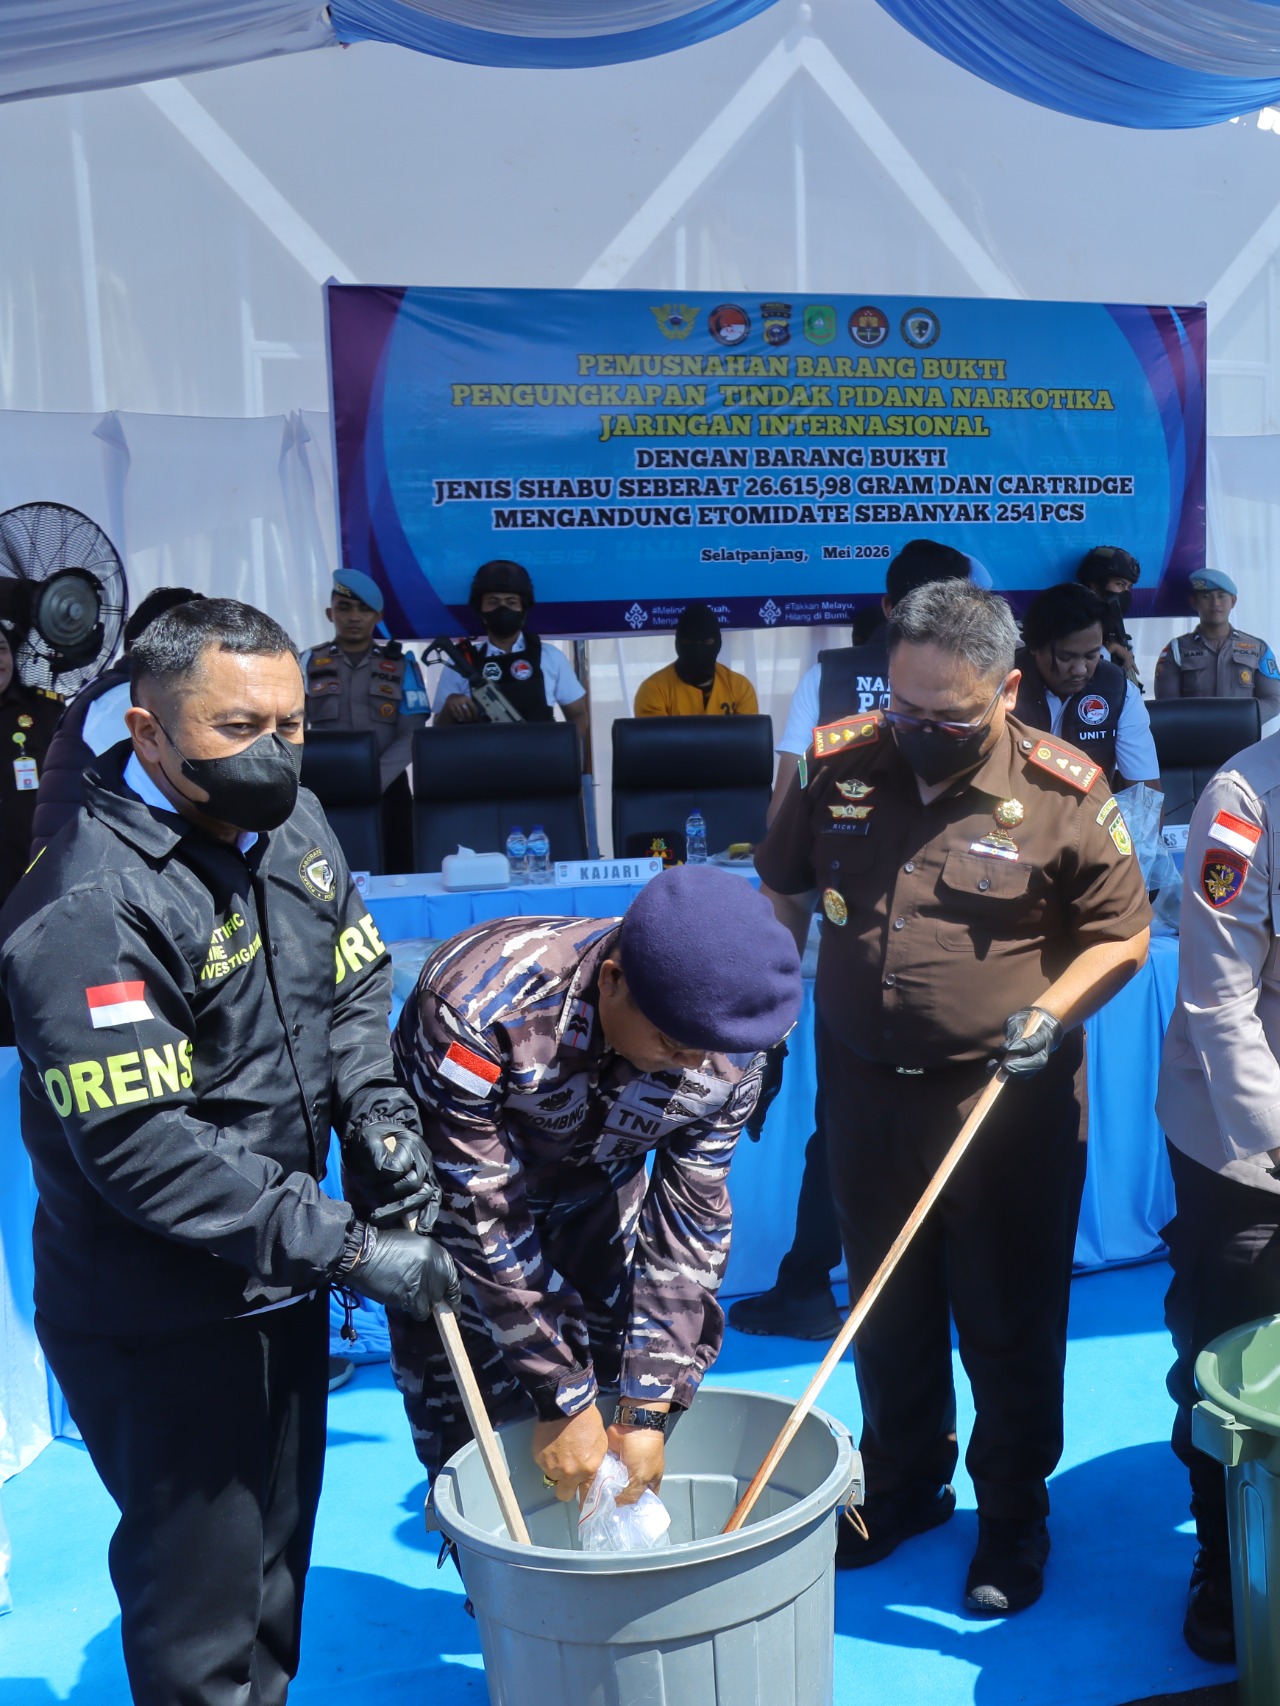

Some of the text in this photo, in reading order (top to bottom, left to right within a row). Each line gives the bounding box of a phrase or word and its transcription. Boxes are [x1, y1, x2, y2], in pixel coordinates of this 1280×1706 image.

[577, 354, 1006, 380] PEMUSNAHAN BARANG BUKTI
[452, 384, 1114, 411] PENGUNGKAPAN TINDAK PIDANA NARKOTIKA
[599, 414, 752, 441] JARINGAN
[757, 415, 989, 437] INTERNASIONAL
[635, 447, 947, 469] DENGAN BARANG BUKTI
[434, 476, 1134, 505] JENIS SHABU SEBERAT 26.615,98 GRAM DAN CARTRIDGE
[493, 503, 1085, 529] MENGANDUNG ETOMIDATE SEBANYAK 254 PCS
[701, 546, 809, 563] Selatpanjang,
[822, 546, 852, 560] Mei
[853, 545, 890, 559] 2026
[652, 606, 687, 615] #Melind
[785, 602, 855, 612] #Takkan Melayu,
[785, 612, 812, 621] Hilang
[813, 612, 822, 620] di
[652, 617, 679, 626] Menja
[816, 730, 824, 753] JAKSA
[1079, 730, 1106, 740] UNIT
[1082, 768, 1097, 788] JAKSA
[579, 865, 640, 880] KAJARI
[619, 1109, 662, 1136] TNI
